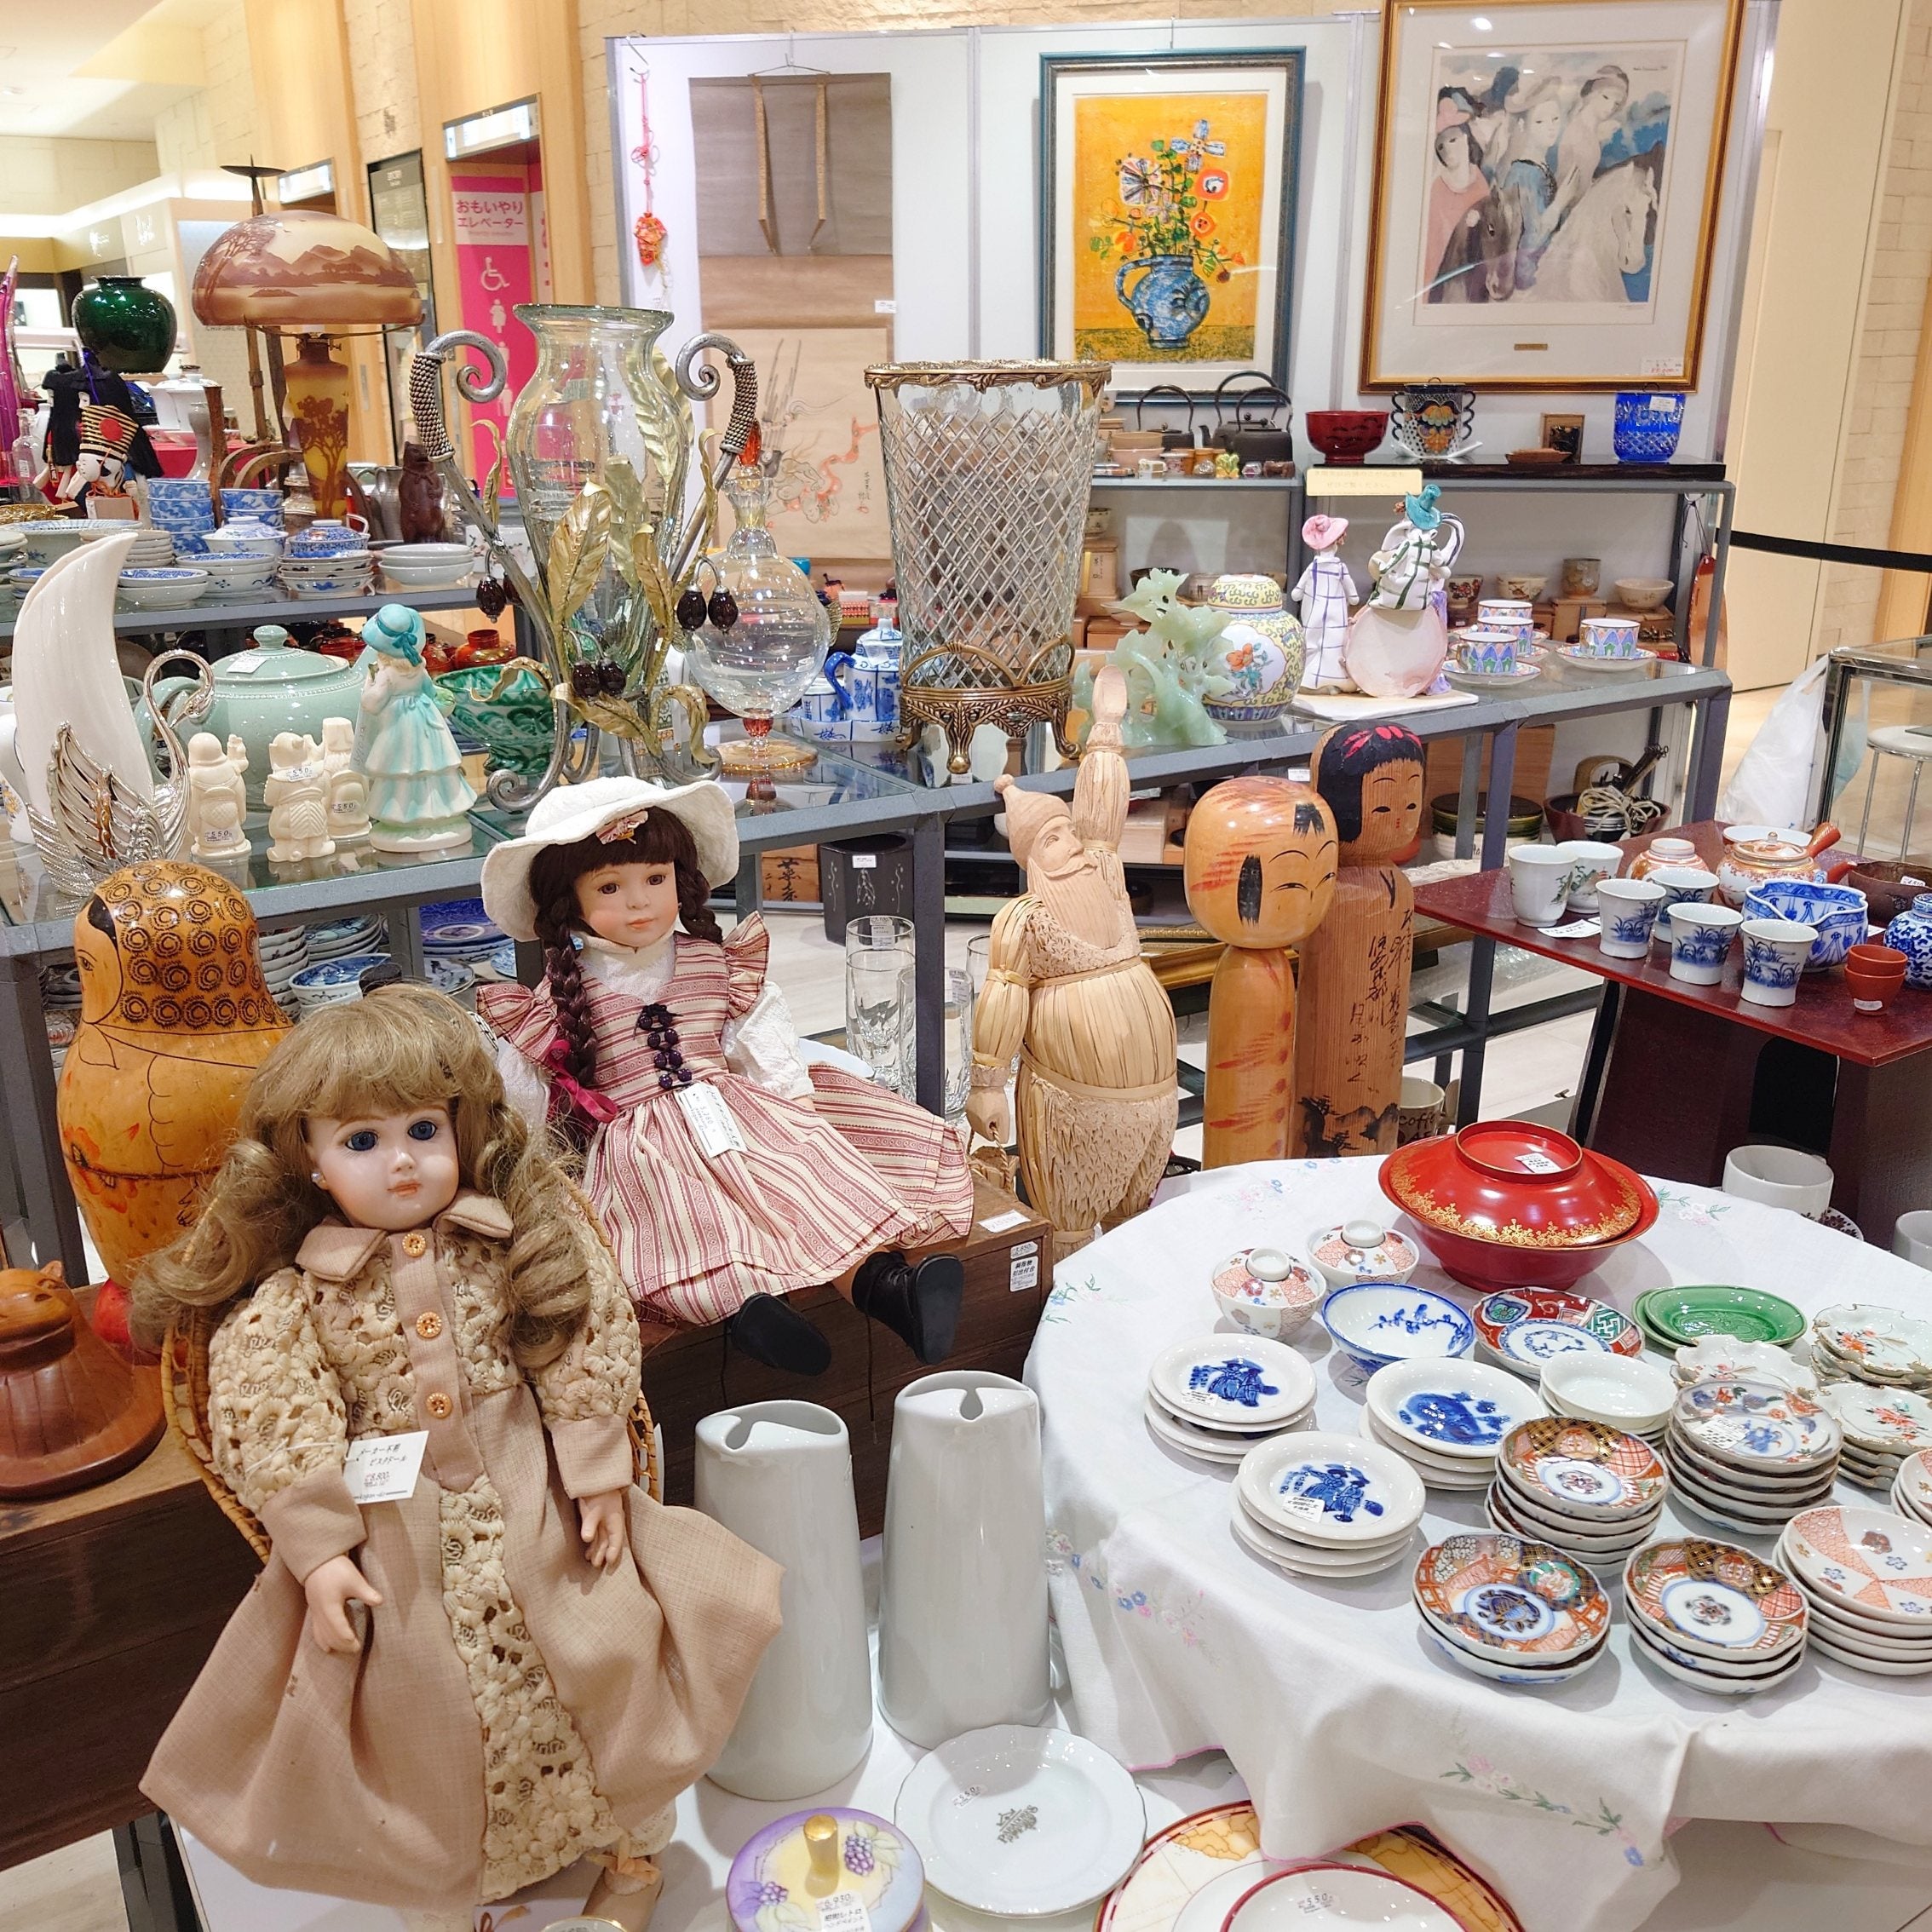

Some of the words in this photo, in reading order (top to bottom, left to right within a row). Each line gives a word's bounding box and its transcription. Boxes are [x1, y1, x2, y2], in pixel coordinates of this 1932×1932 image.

[457, 200, 523, 214] おもいやり
[457, 216, 524, 228] エレベーター
[958, 1786, 975, 1799] 550
[1307, 1893, 1327, 1906] 550
